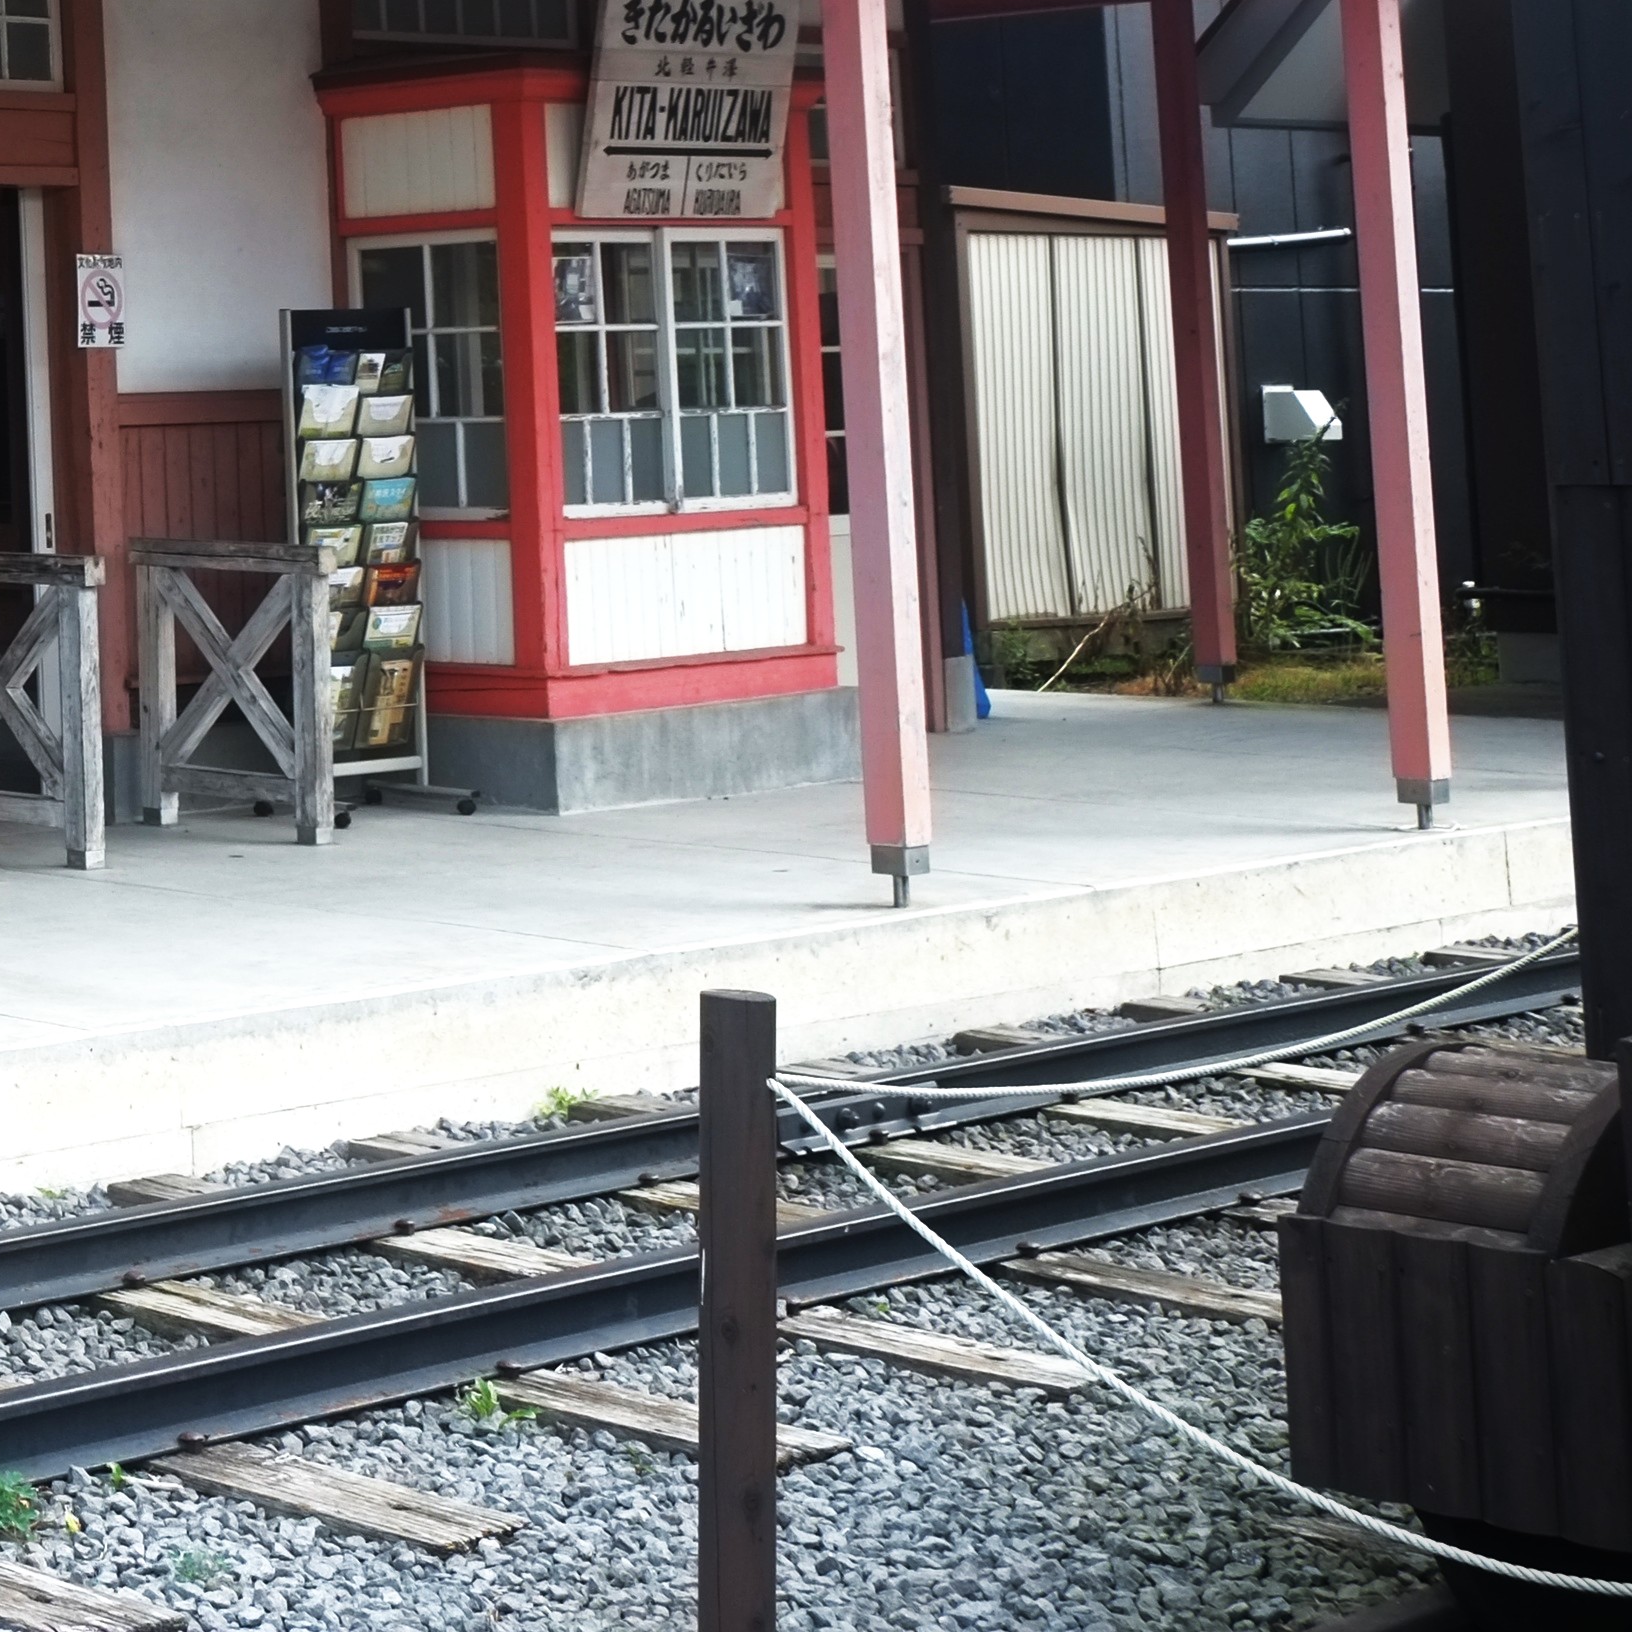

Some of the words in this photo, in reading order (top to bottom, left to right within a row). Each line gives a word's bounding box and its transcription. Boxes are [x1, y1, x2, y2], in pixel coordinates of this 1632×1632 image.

[609, 85, 773, 144] KITA-KARUIZAWA
[624, 188, 671, 215] AGATSUMA
[80, 321, 125, 345] 禁煙
